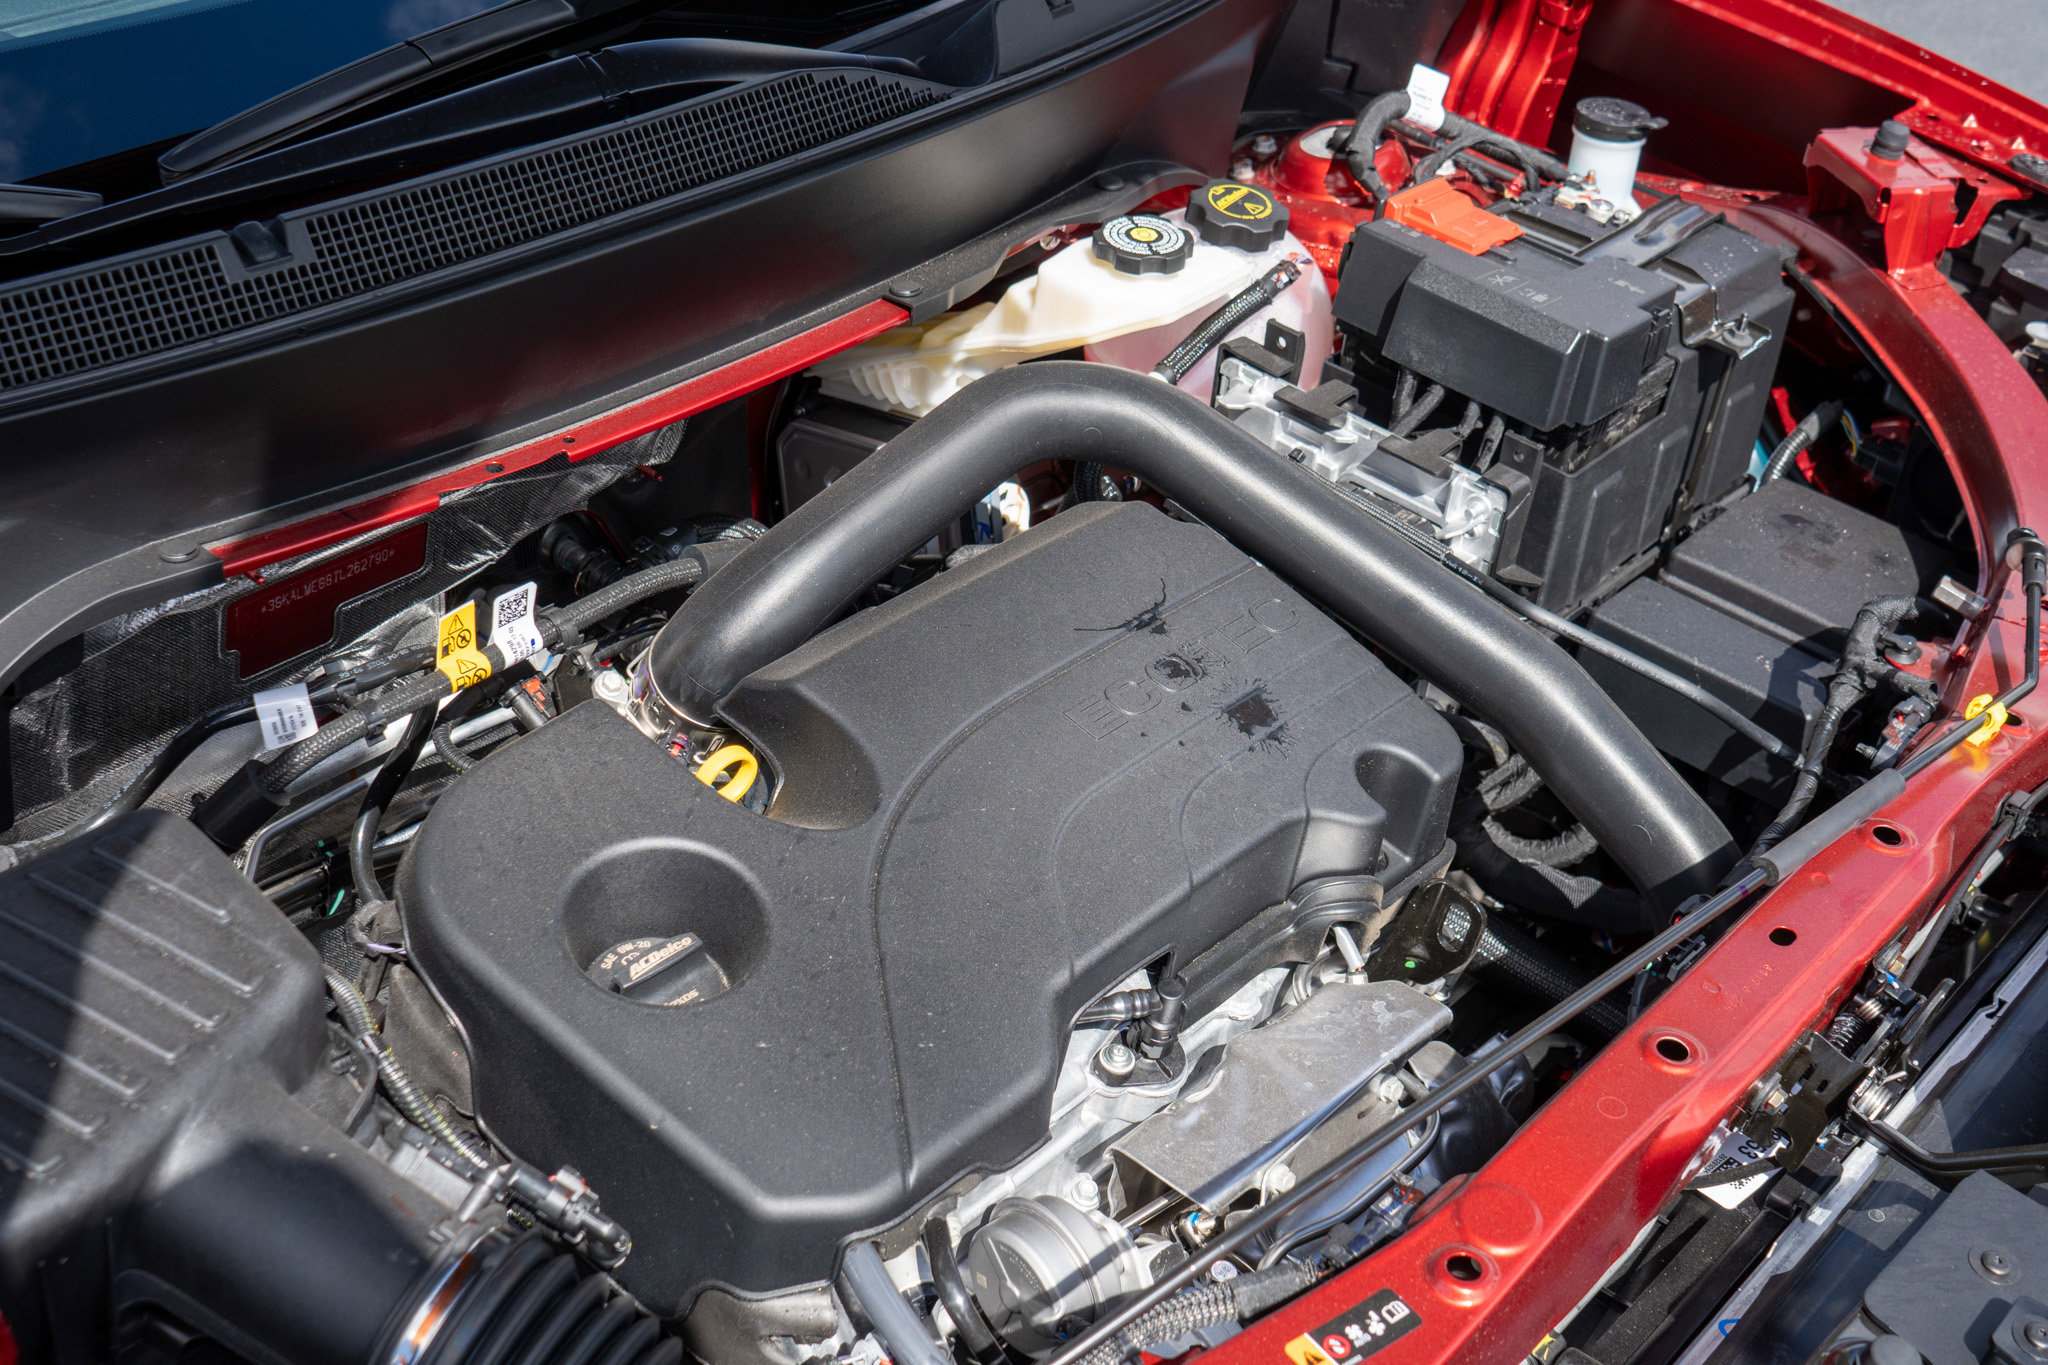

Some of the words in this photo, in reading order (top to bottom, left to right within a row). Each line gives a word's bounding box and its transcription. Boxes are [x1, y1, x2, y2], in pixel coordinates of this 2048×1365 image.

[1064, 598, 1303, 741] ECOTEC
[601, 953, 618, 969] SAE
[617, 941, 651, 954] 0W-20
[629, 937, 692, 980] ACDelco
